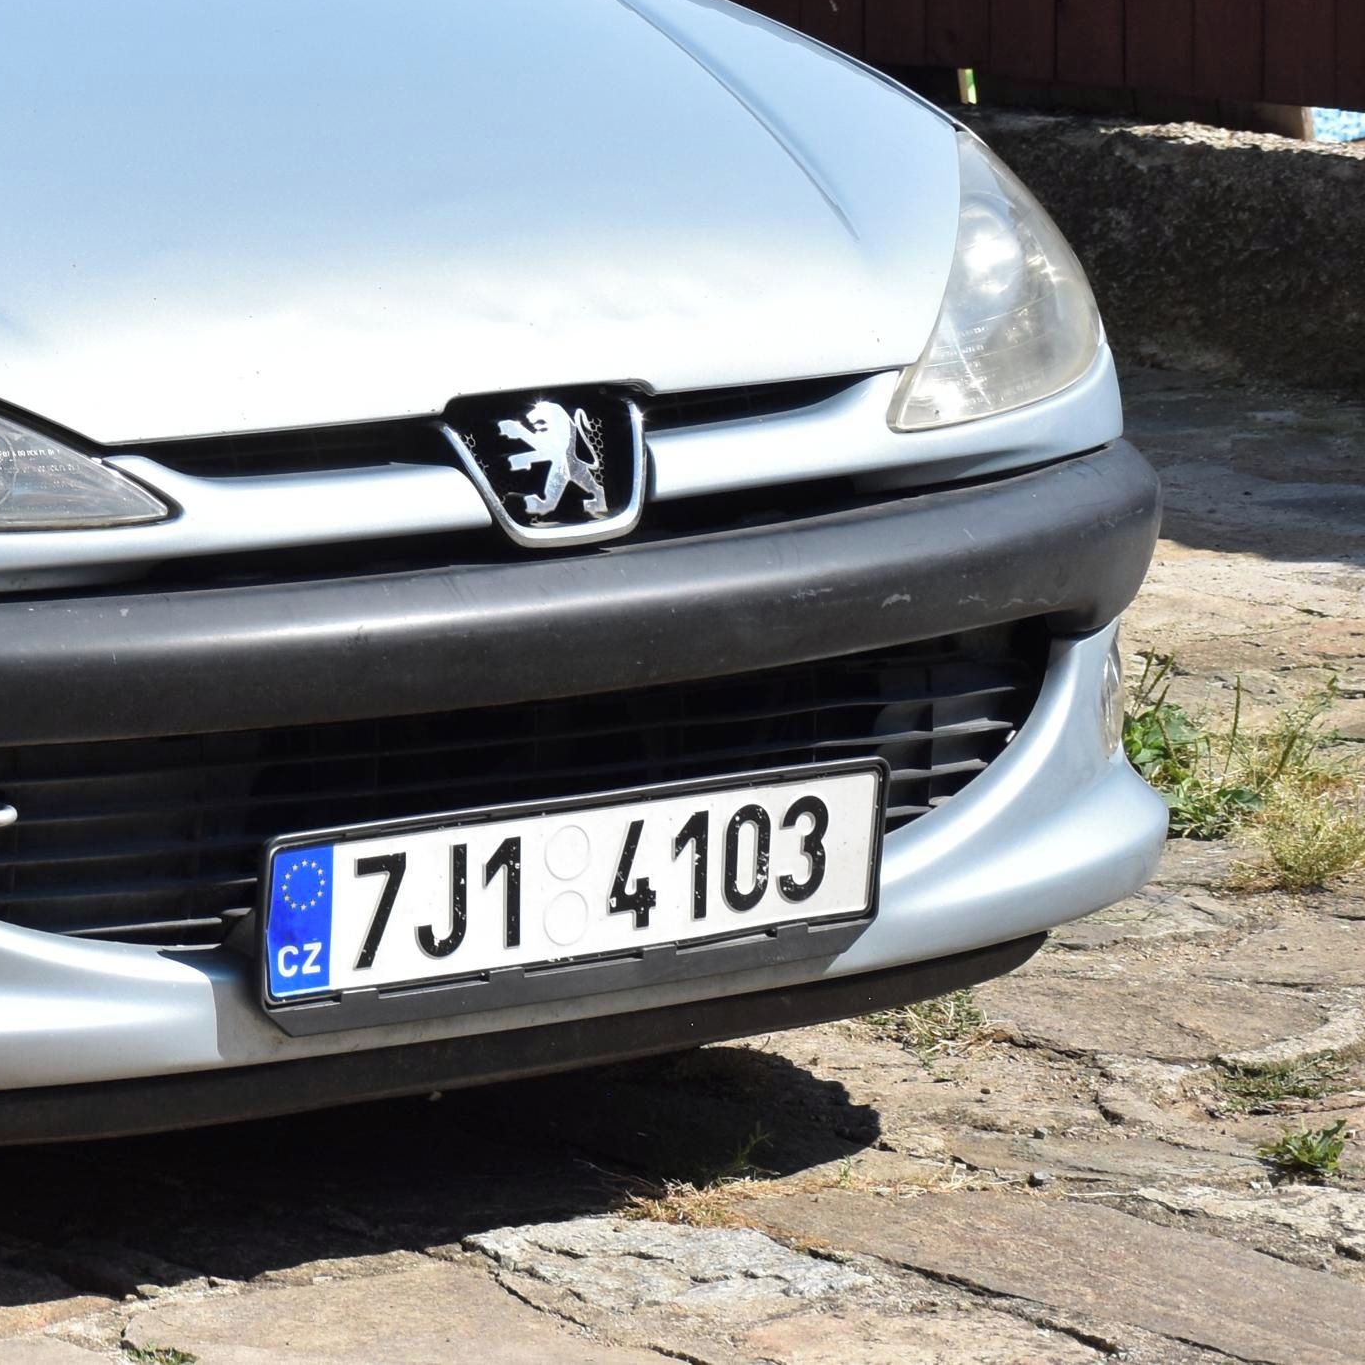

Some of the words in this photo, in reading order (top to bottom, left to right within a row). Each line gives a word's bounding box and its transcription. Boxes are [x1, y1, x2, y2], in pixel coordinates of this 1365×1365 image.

[354, 836, 521, 970] 7J1
[607, 795, 829, 928] 4103
[277, 941, 322, 978] CZ
